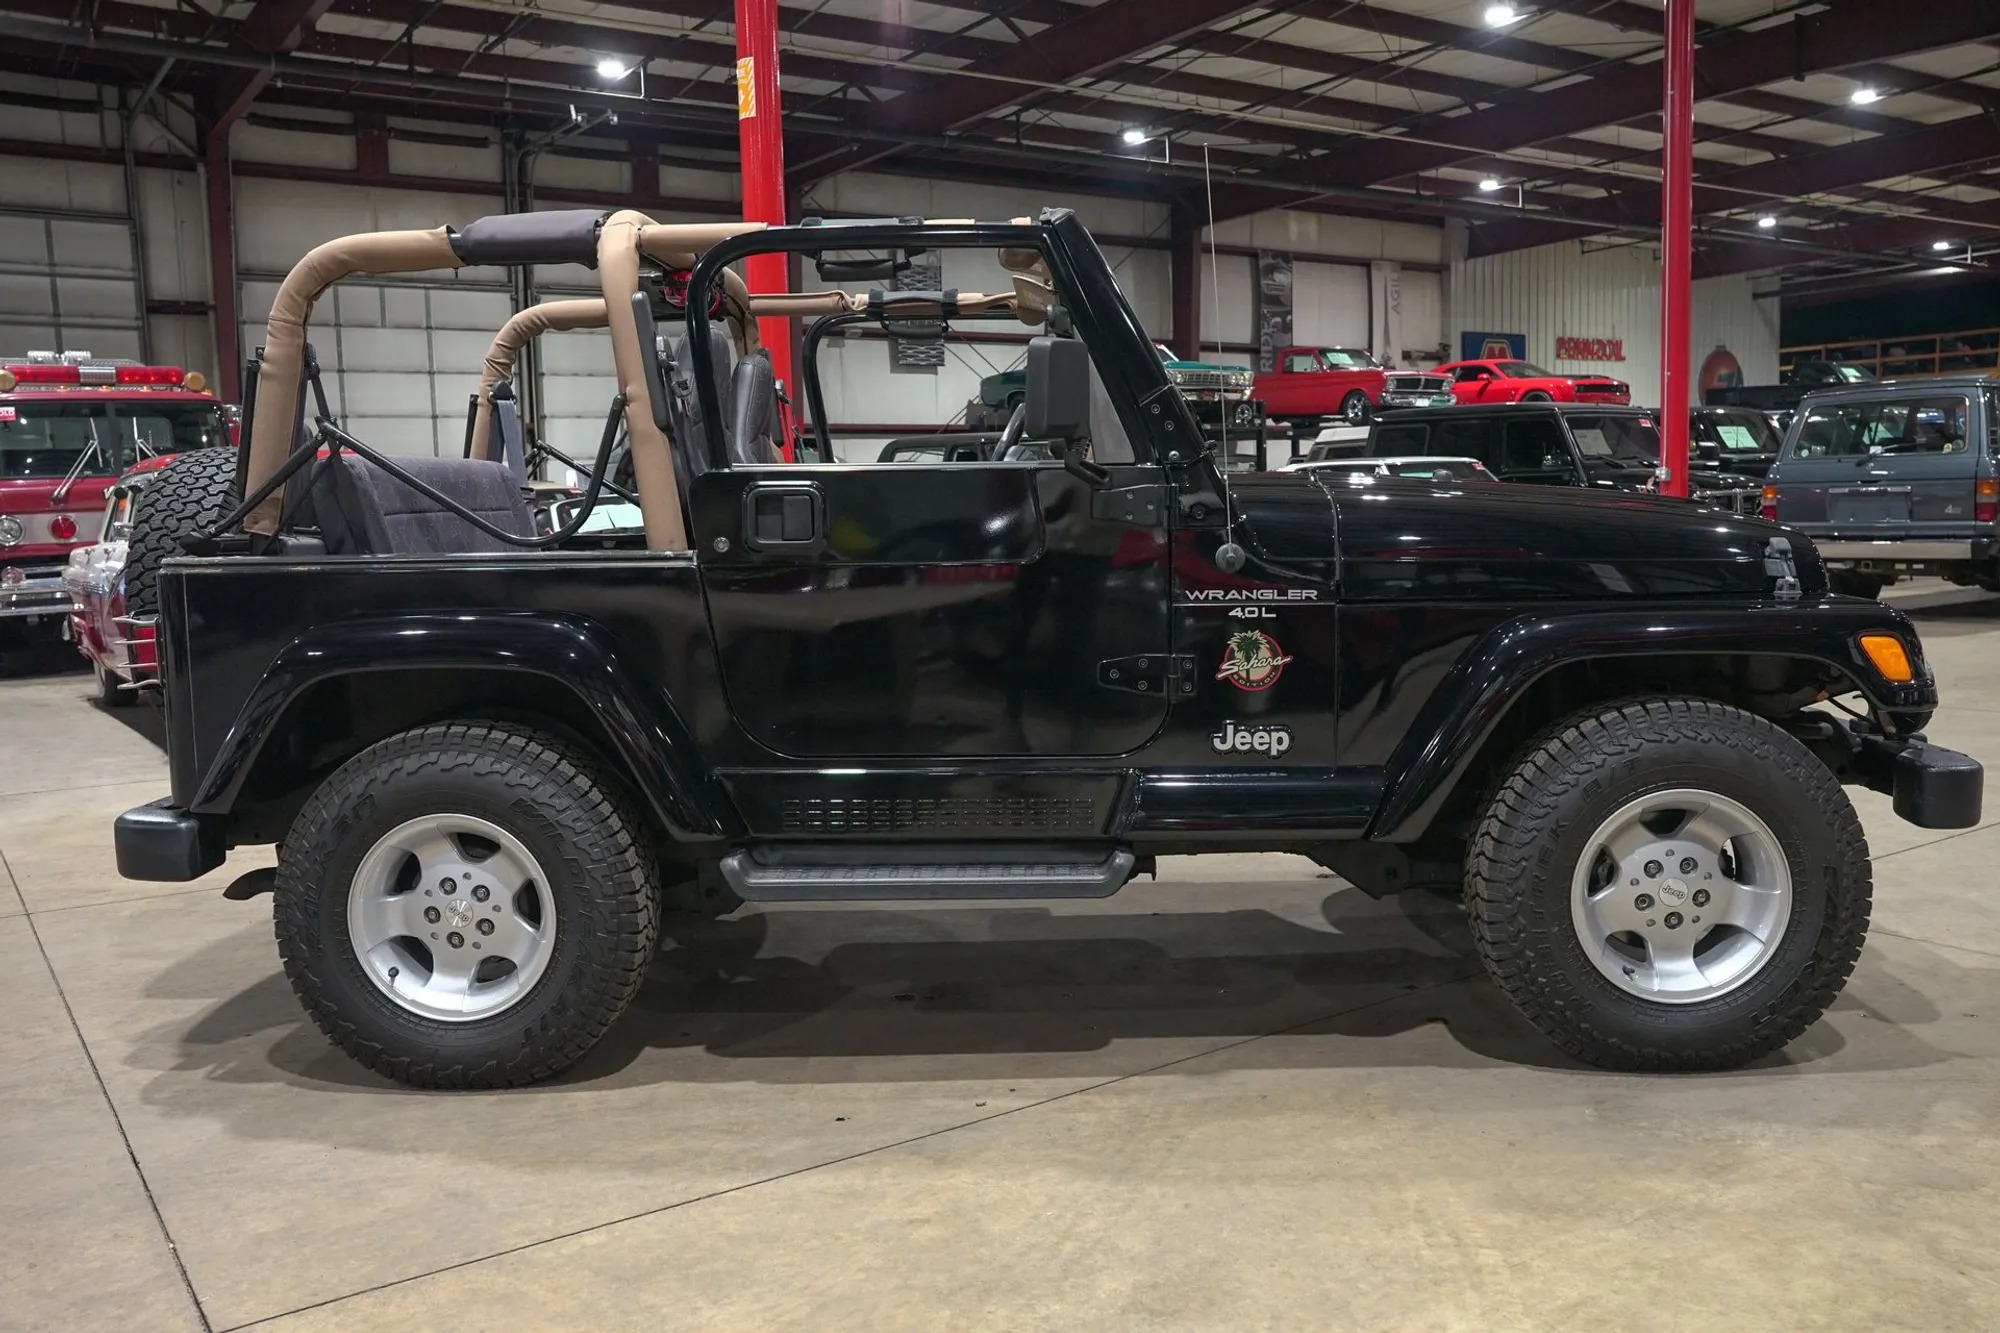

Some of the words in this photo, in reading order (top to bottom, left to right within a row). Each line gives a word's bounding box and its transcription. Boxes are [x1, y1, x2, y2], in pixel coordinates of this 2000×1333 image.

[1186, 589, 1318, 600] WRANGLER
[1217, 653, 1291, 679] Sahara
[1232, 671, 1276, 687] EDITION
[1212, 724, 1291, 757] Jeep
[1662, 885, 1685, 900] Jeep
